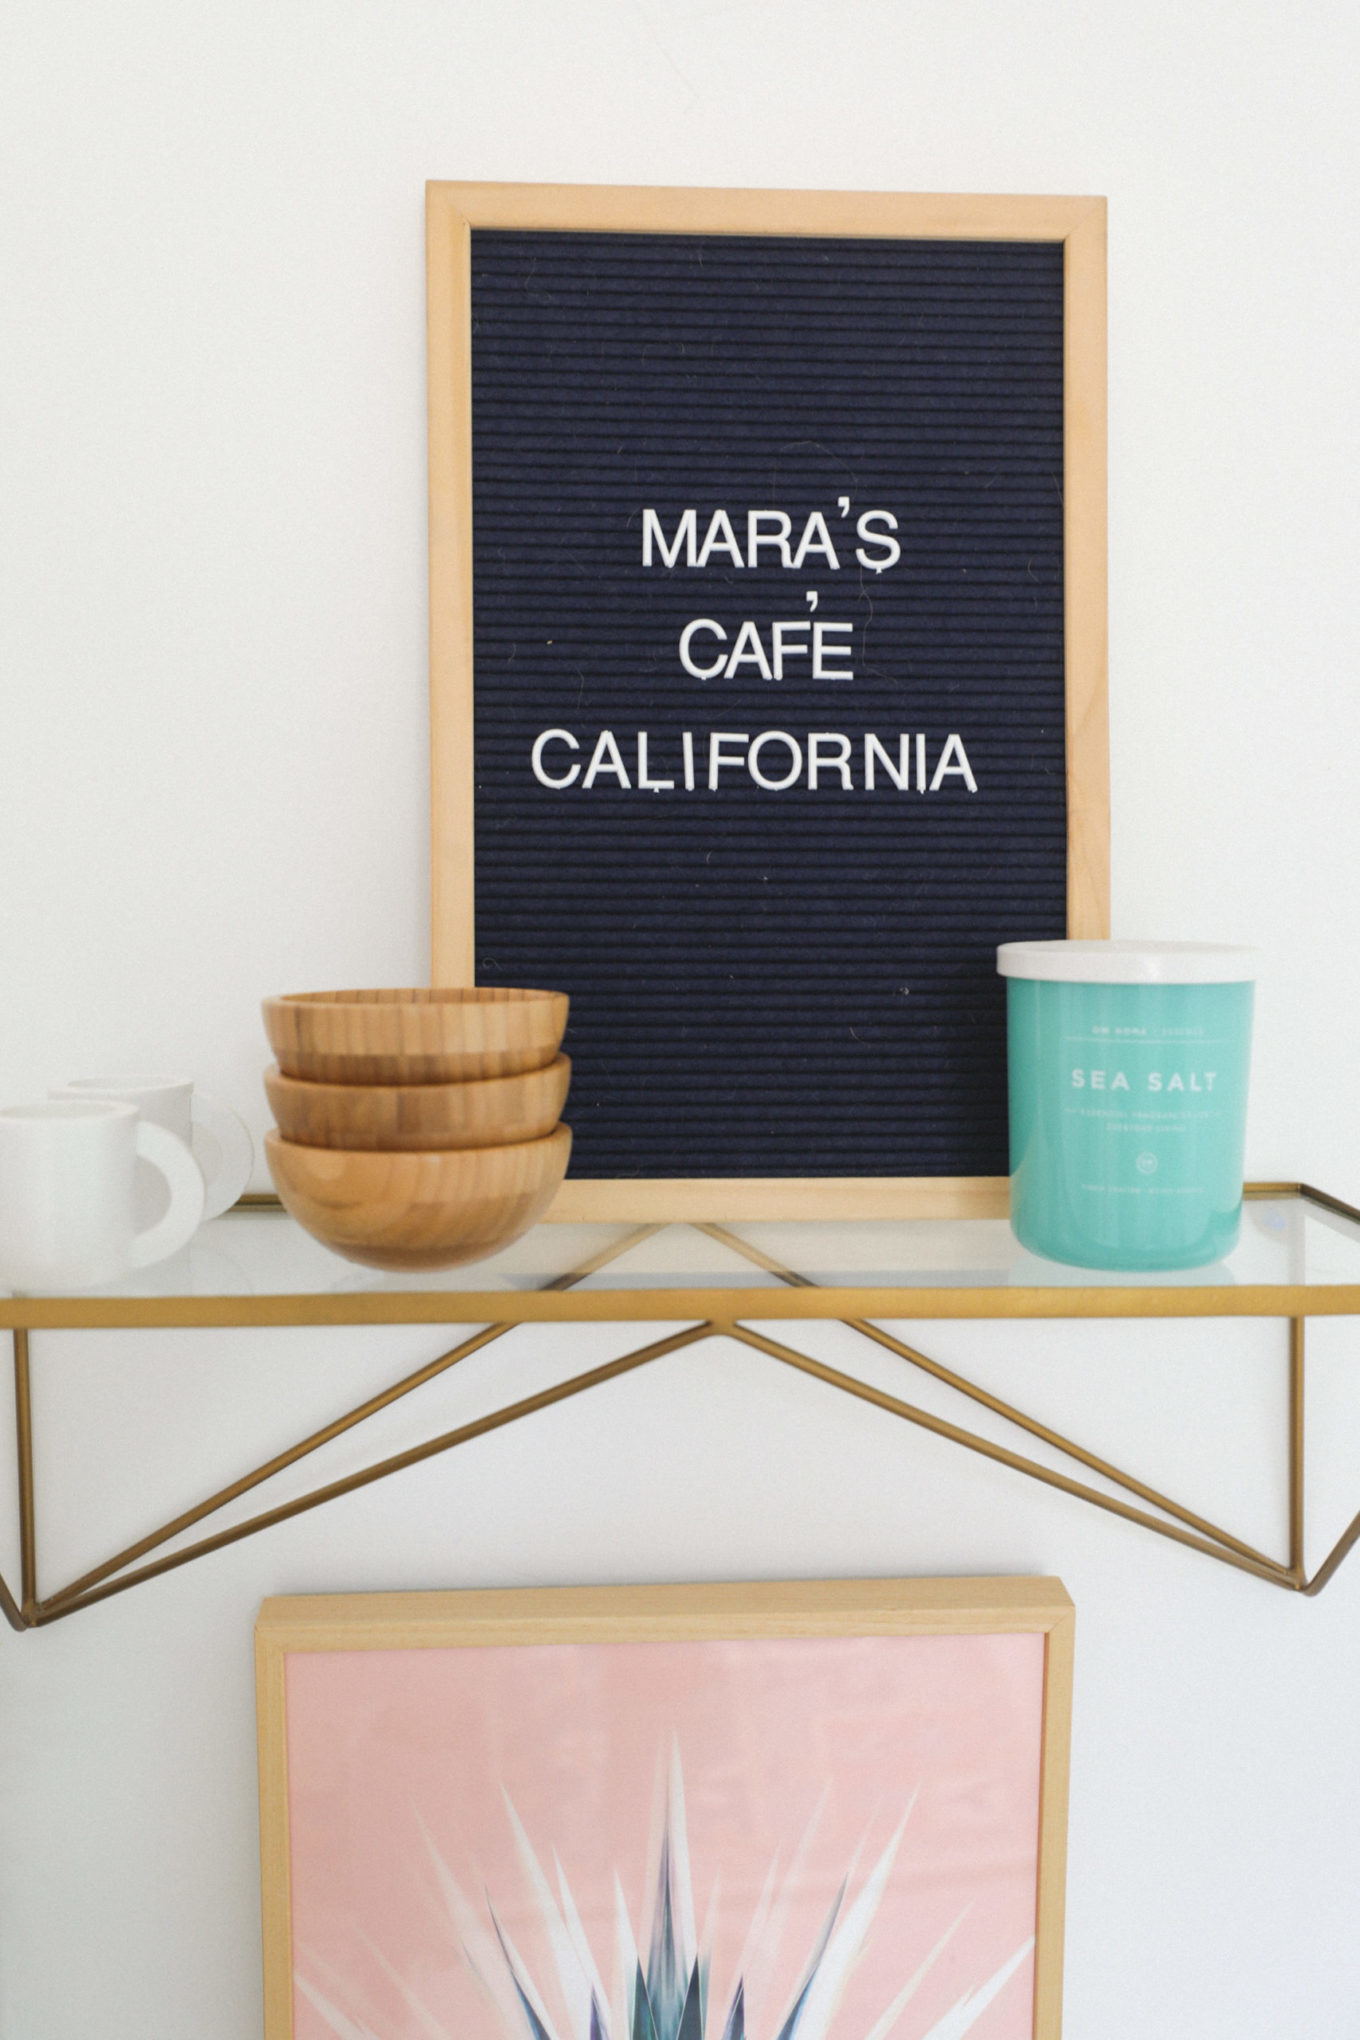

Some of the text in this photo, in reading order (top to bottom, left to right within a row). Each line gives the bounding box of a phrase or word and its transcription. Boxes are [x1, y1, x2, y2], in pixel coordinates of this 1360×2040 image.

[642, 496, 901, 574] MARA'S
[531, 728, 979, 795] CALIFORNIA
[1071, 1068, 1217, 1093] SEA SALT
